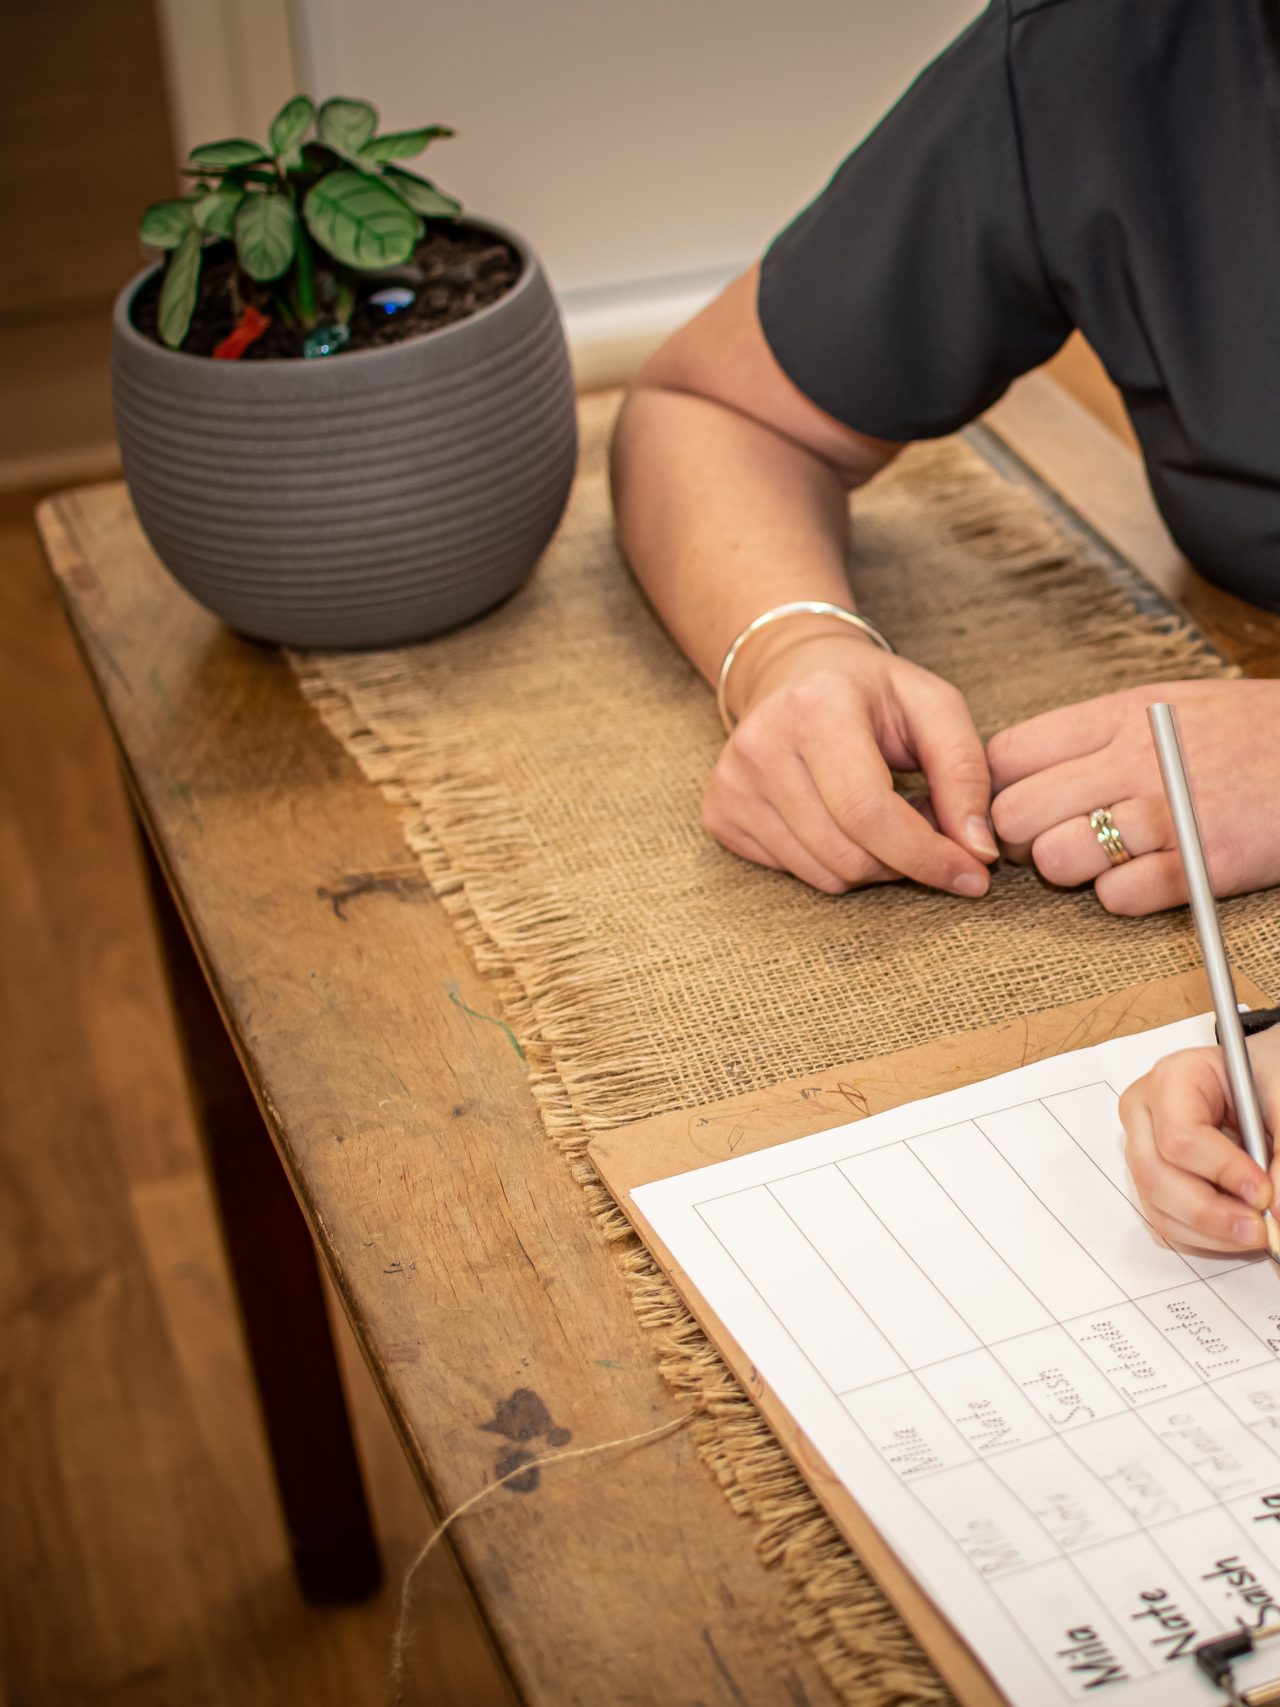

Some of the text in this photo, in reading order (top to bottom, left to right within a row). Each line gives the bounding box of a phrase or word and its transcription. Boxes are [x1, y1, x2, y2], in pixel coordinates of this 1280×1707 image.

[1079, 1320, 1168, 1404] Tatenda
[1163, 1300, 1240, 1378] Torsten
[956, 1399, 1021, 1451] Nate
[1022, 1369, 1096, 1425] Saish
[881, 1427, 945, 1476] Mila
[1057, 1624, 1130, 1691] Mila
[1131, 1588, 1197, 1661] Nate
